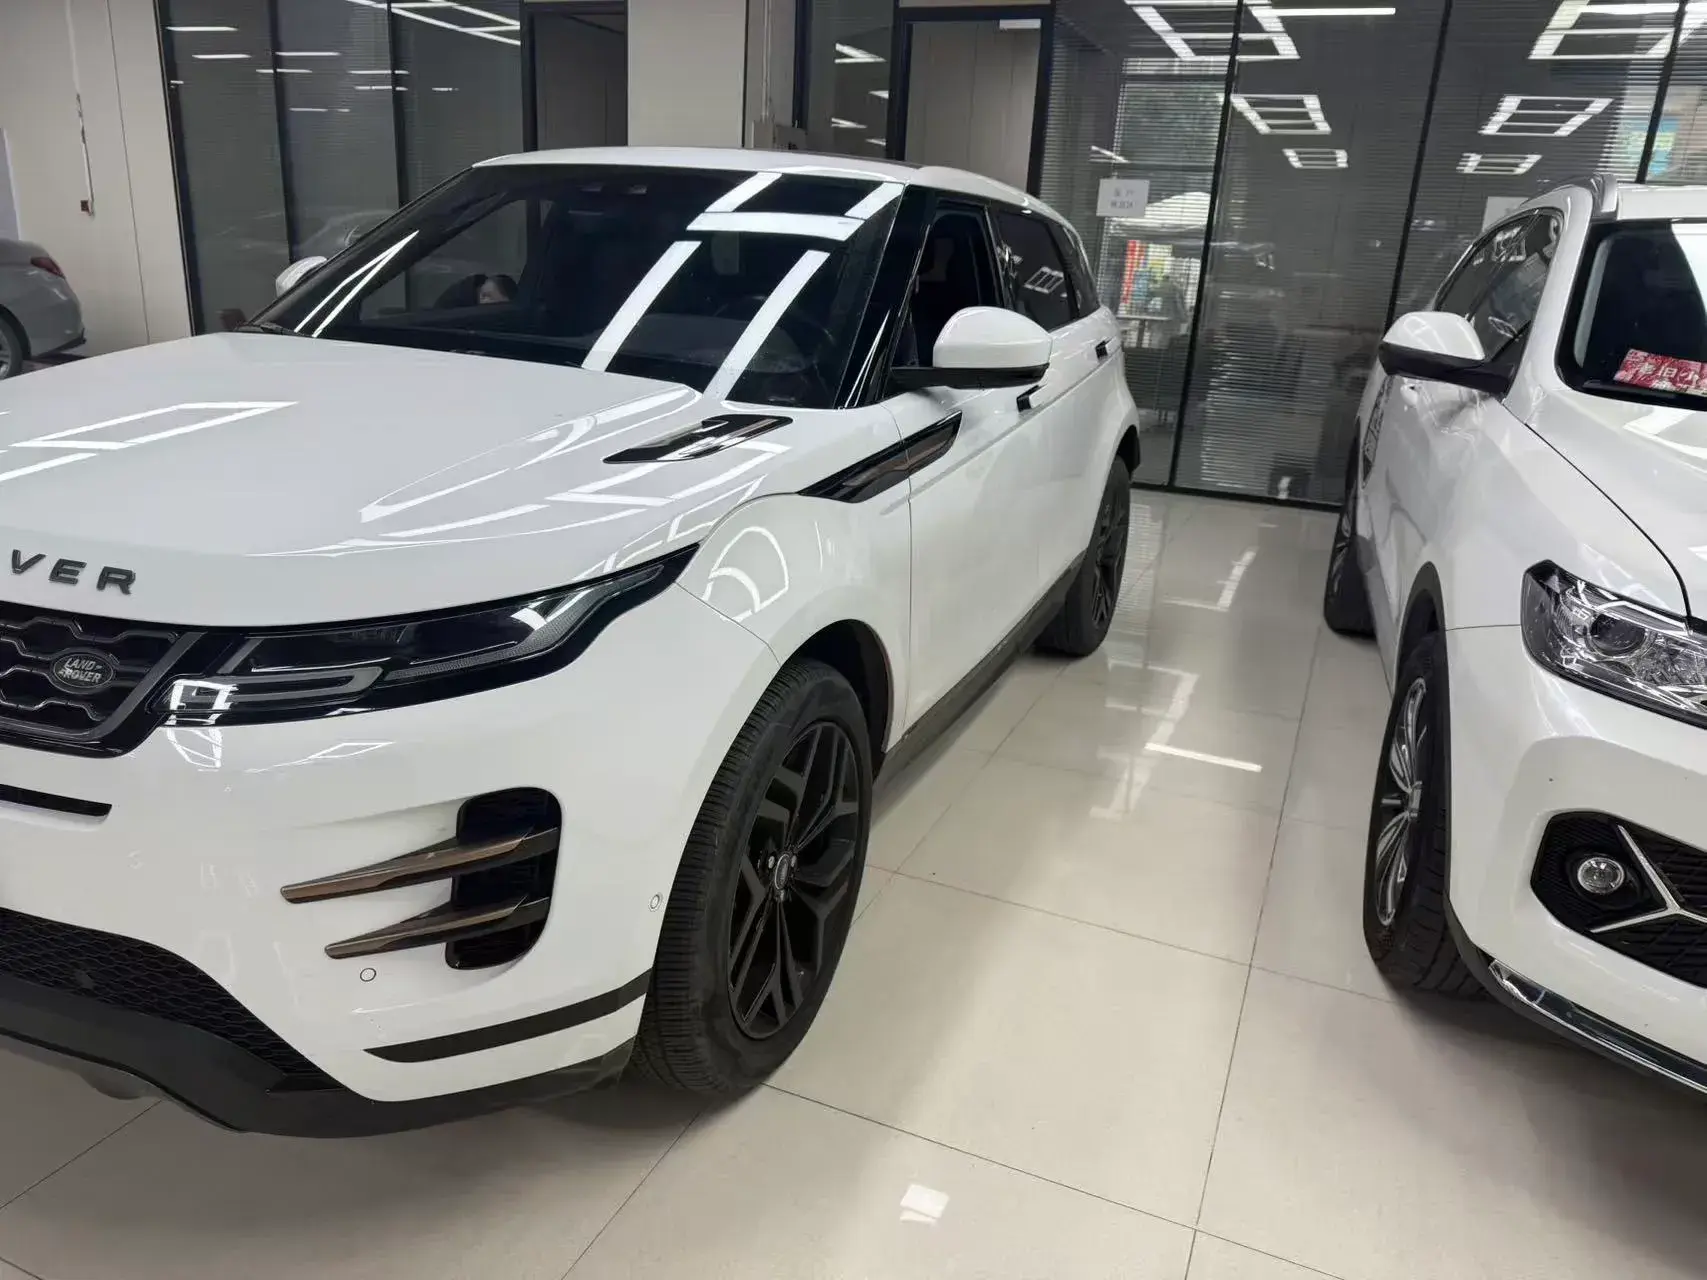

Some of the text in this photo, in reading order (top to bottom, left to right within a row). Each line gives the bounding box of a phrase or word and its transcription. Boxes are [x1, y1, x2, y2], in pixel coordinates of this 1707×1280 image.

[11, 549, 136, 595] VER
[64, 657, 96, 671] LAND
[64, 667, 102, 683] ROVER
